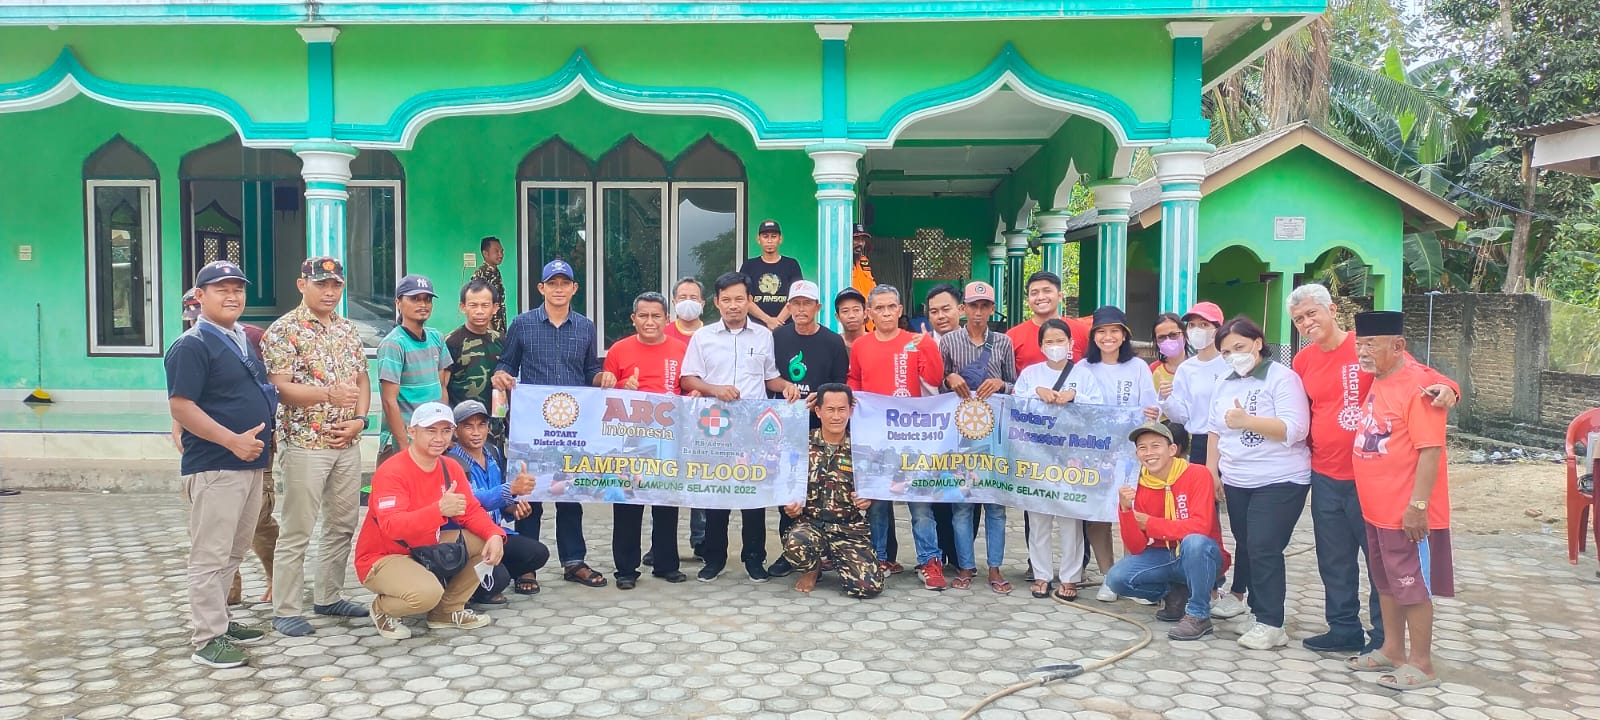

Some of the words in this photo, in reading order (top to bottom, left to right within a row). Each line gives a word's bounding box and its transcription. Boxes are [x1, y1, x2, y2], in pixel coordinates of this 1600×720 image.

[898, 353, 908, 385] Rotary
[1122, 381, 1133, 405] Rotar
[1348, 364, 1360, 401] Rotary
[601, 397, 676, 427] ARC
[1249, 389, 1260, 416] otar
[886, 409, 951, 430] Rotary
[1010, 408, 1057, 429] Rotary
[543, 430, 578, 438] ROTARY
[601, 422, 675, 440] Indonesia
[887, 431, 920, 440] District
[921, 431, 943, 440] 3410
[1008, 427, 1067, 446] Disaster
[1068, 434, 1112, 450] Relief
[683, 447, 708, 455] Bandar
[562, 455, 679, 477] LAMPUNG
[686, 462, 767, 481] FLOOD
[901, 452, 1009, 475] LAMPUNG
[1015, 459, 1100, 486] FLOOD
[638, 480, 684, 490] LAMPUNG
[686, 483, 731, 494] SELATAN
[734, 485, 757, 494] 2022
[972, 479, 1014, 492] LAMPUNG
[1016, 486, 1060, 500] SELATAN
[1063, 492, 1087, 502] 2022
[1177, 494, 1189, 520] Rota
